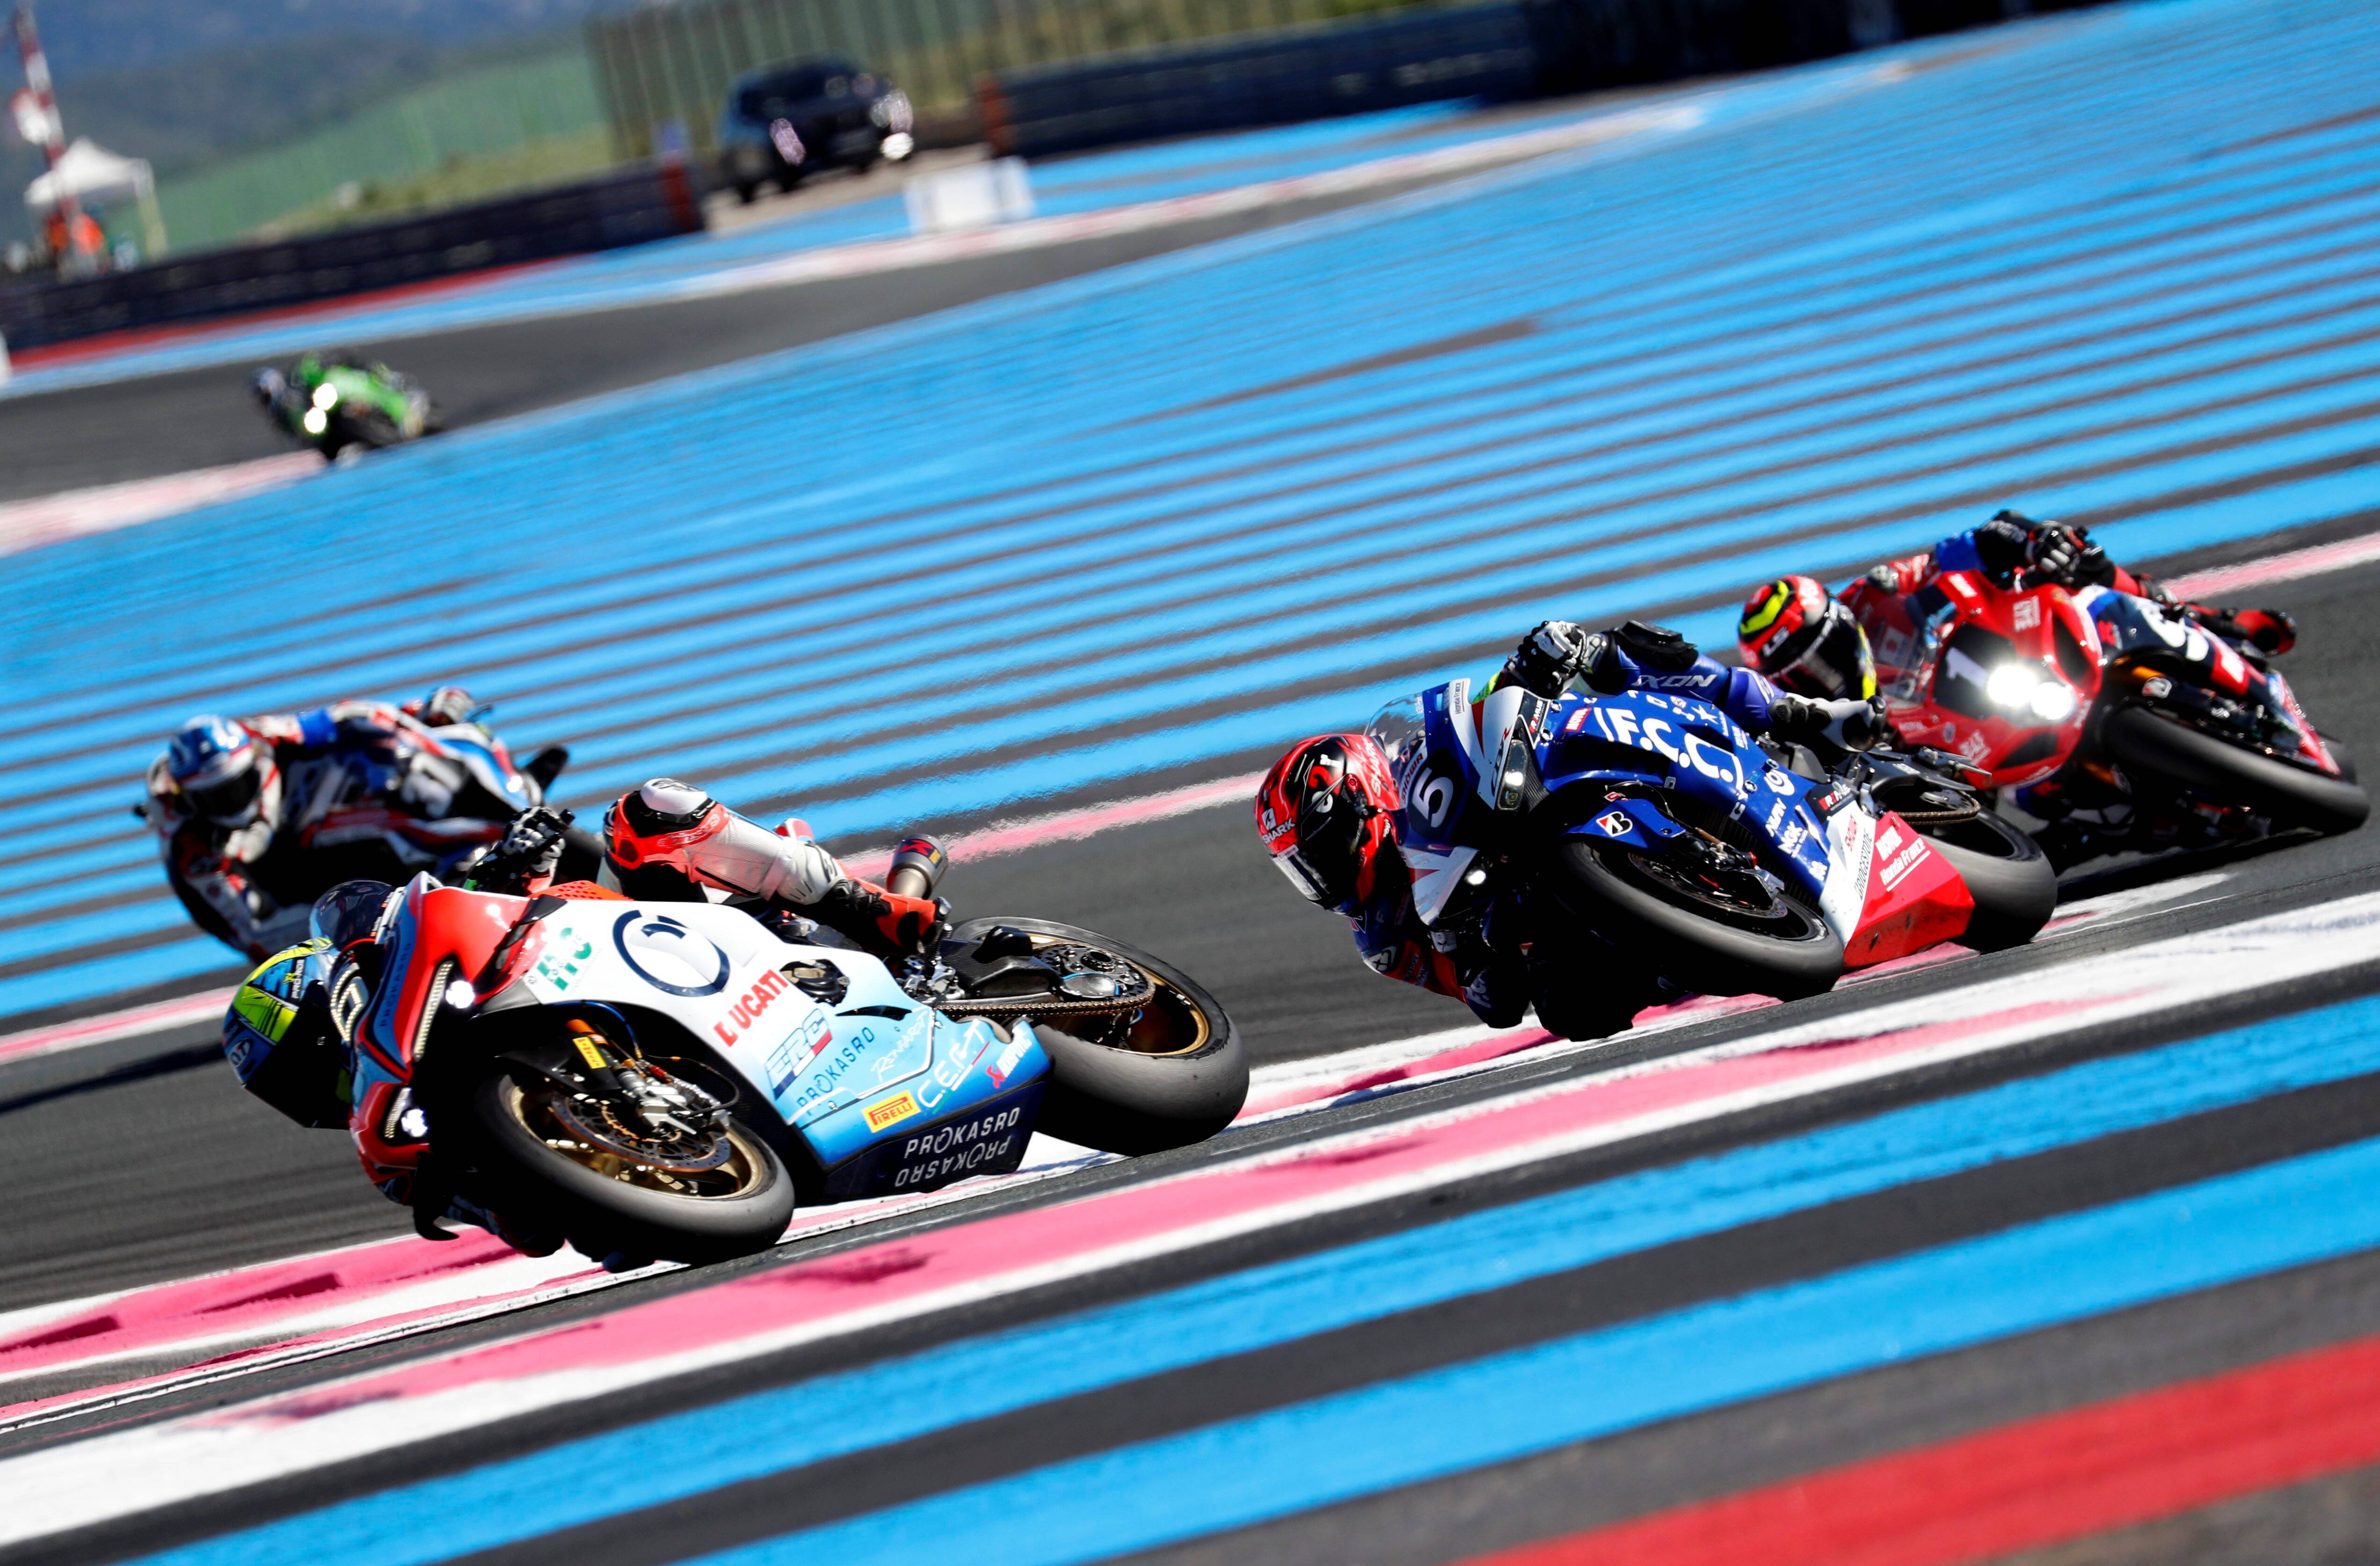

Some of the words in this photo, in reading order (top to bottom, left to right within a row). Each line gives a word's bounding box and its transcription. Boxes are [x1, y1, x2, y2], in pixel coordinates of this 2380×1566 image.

[1565, 707, 1591, 731] MOTUL
[1606, 708, 1734, 783] F.C.C.
[1411, 767, 1454, 828] 5
[1261, 817, 1296, 843] SHARK
[1778, 820, 1802, 855] NGK
[1875, 825, 1903, 862] MOTUL
[1879, 856, 1905, 885] Honda
[1900, 837, 1926, 867] France
[796, 1027, 875, 1116] PROKASRO
[868, 1096, 913, 1126] PIRELLI
[904, 1107, 1021, 1159] PROKASRO
